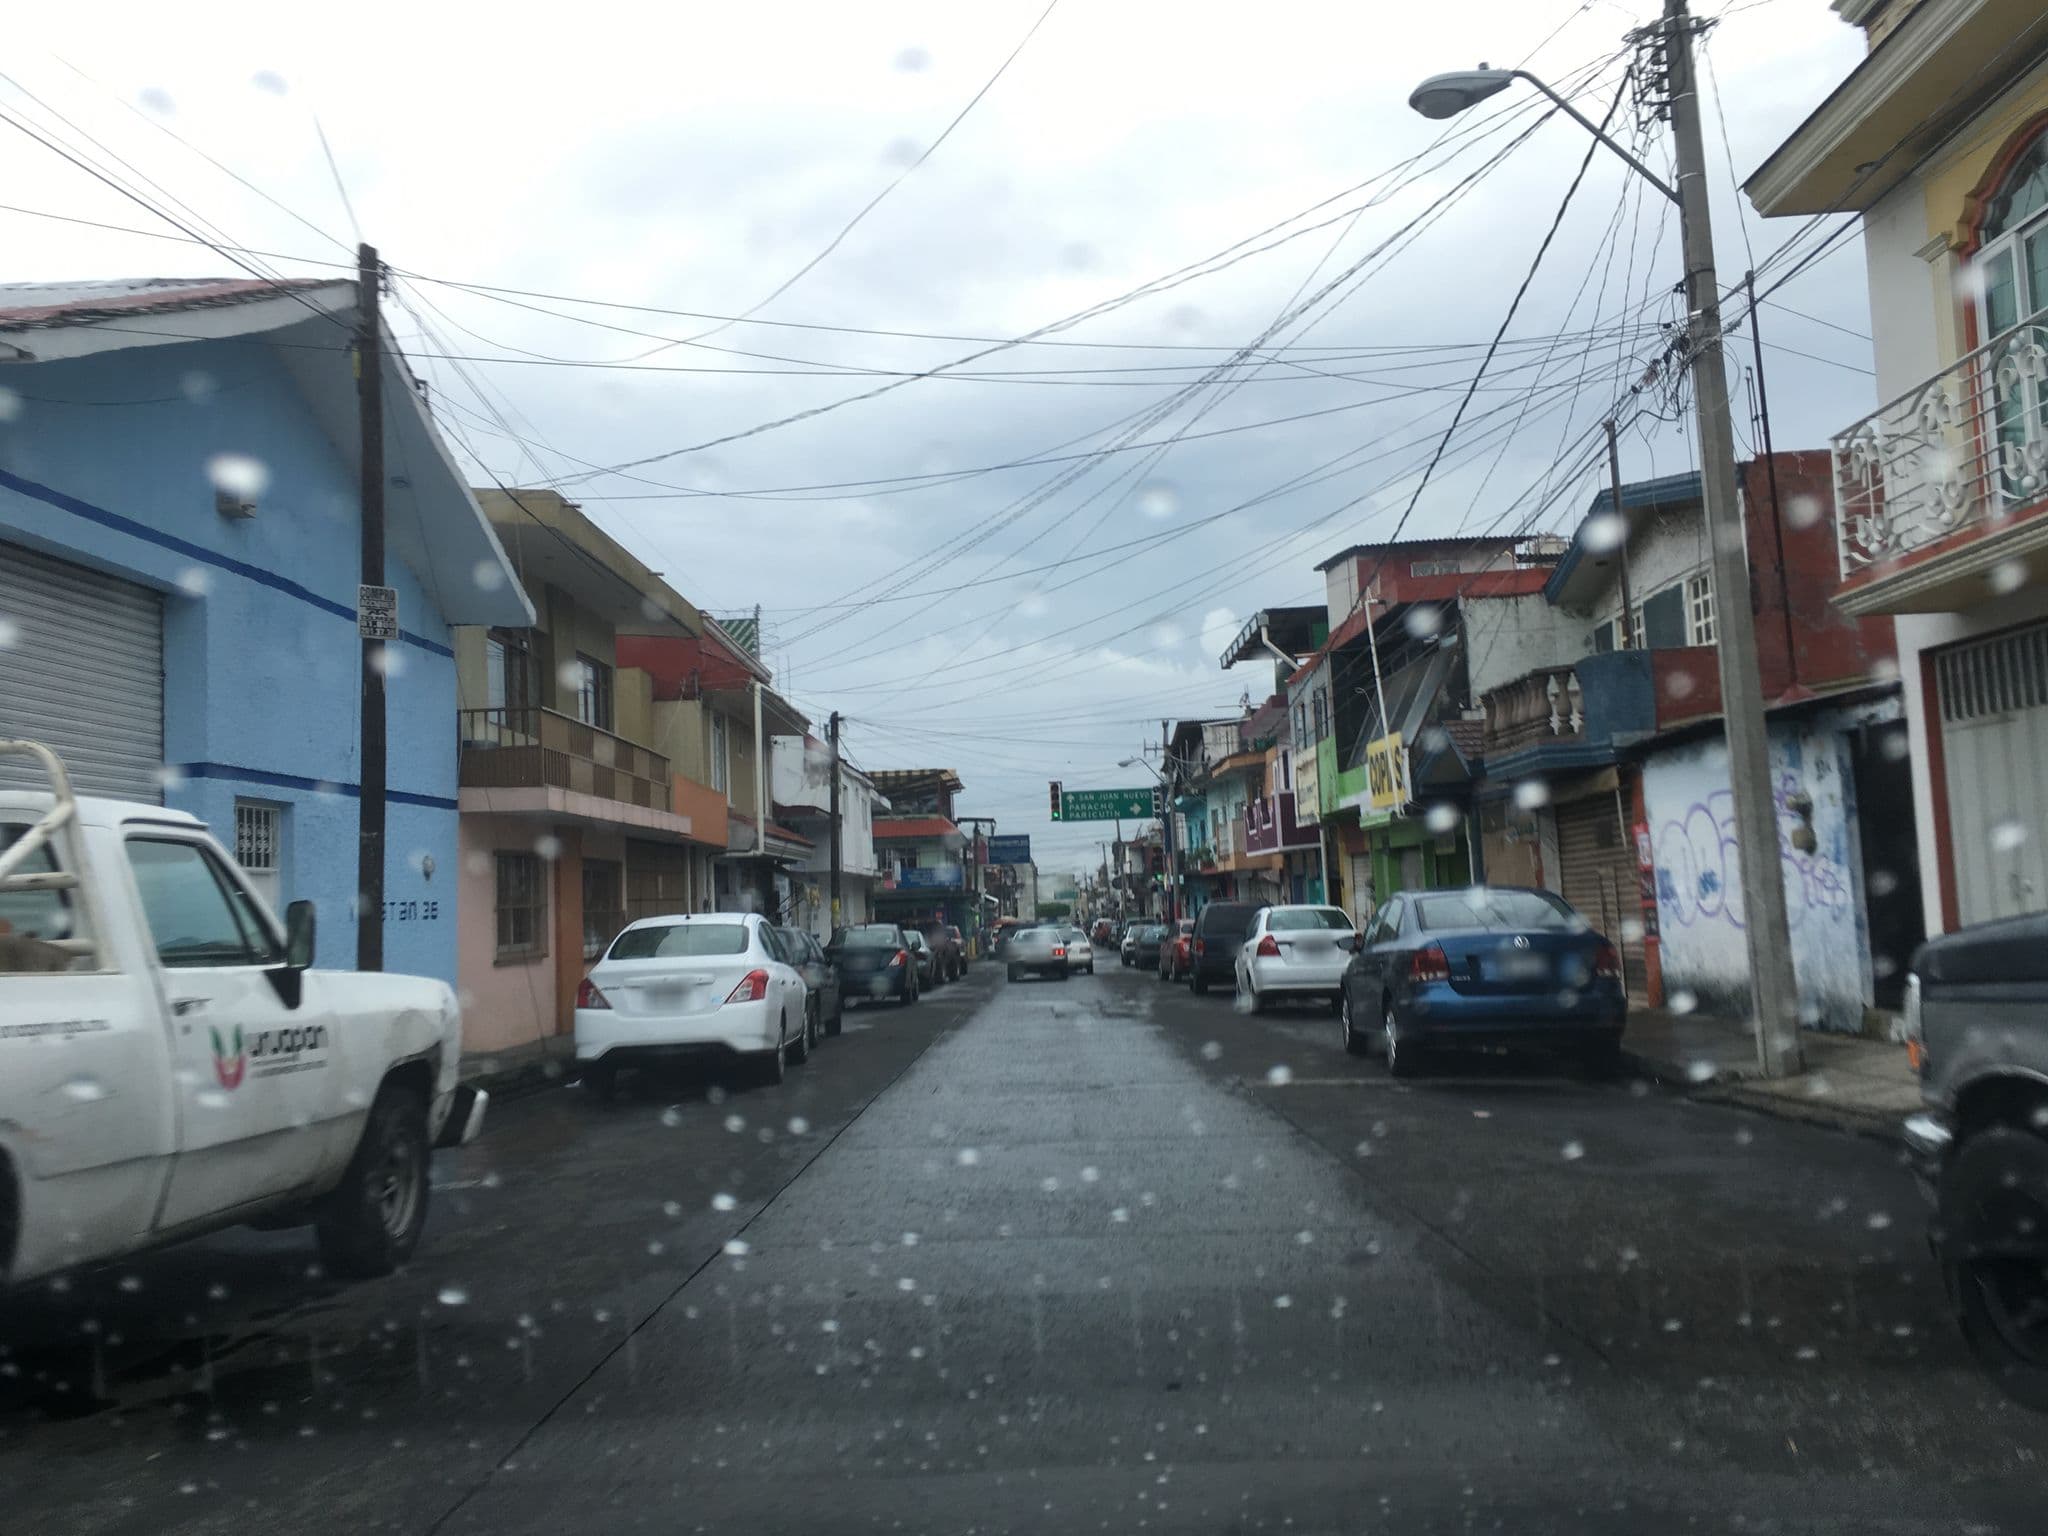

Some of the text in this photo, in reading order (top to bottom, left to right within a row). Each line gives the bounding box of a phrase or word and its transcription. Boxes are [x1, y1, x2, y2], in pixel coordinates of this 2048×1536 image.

[1369, 745, 1404, 797] COPIS
[1079, 790, 1151, 801] SAN JUAN NUEVO
[1069, 802, 1114, 811] PARACHO
